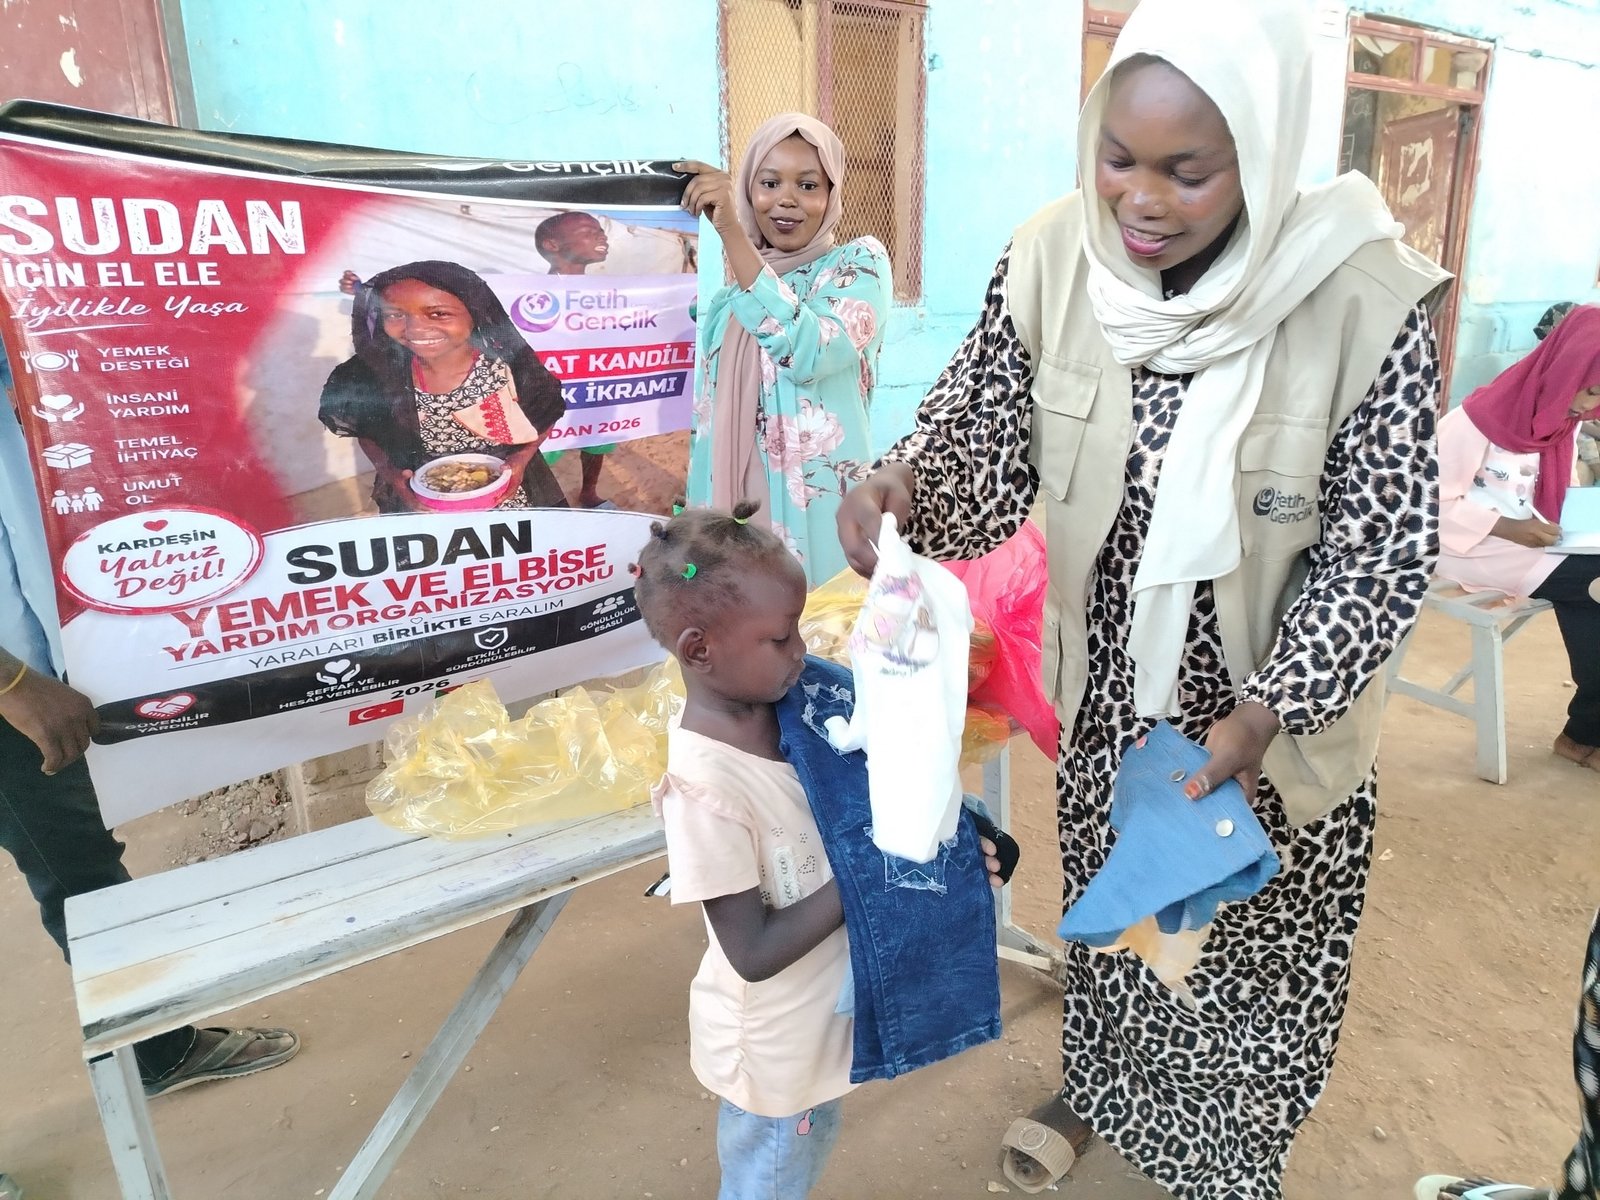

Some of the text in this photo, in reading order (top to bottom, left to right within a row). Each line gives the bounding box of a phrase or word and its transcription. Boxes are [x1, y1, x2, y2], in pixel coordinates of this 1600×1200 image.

[0, 195, 306, 255] SUDAN
[2, 257, 221, 292] İÇİN EL ELE
[10, 294, 249, 328] İyilikle Yaşa
[565, 310, 658, 331] Gençlik
[97, 345, 170, 358] YEMEK
[588, 343, 696, 372] KANDİLİ
[100, 356, 189, 372] DESTEĞİ
[106, 388, 179, 405] İNSANİ
[585, 376, 678, 403] İKRAMI
[108, 404, 190, 419] YARDIM
[598, 417, 641, 434] 2026
[115, 435, 182, 450] TEMEL
[117, 447, 199, 463] İHTİYAÇ
[123, 476, 183, 492] UMUT
[125, 494, 154, 506] OL
[97, 529, 217, 555] KARDEŞİN
[285, 519, 533, 585] SUDAN
[100, 545, 220, 579] Yalnız
[113, 558, 226, 599] Değil!
[171, 543, 607, 639] YEMEK VE ELBİSE
[163, 564, 614, 663] YARDIM ORGANİZASYONU
[248, 599, 564, 669] YARALARI BİRLİKTE SARALIM
[594, 617, 623, 633] ESASLI
[503, 645, 517, 653] VE
[306, 677, 375, 698] ŞEFFAF VE
[390, 679, 450, 700] 2026
[279, 695, 324, 709] HESAP
[138, 721, 198, 733] YARDIM
